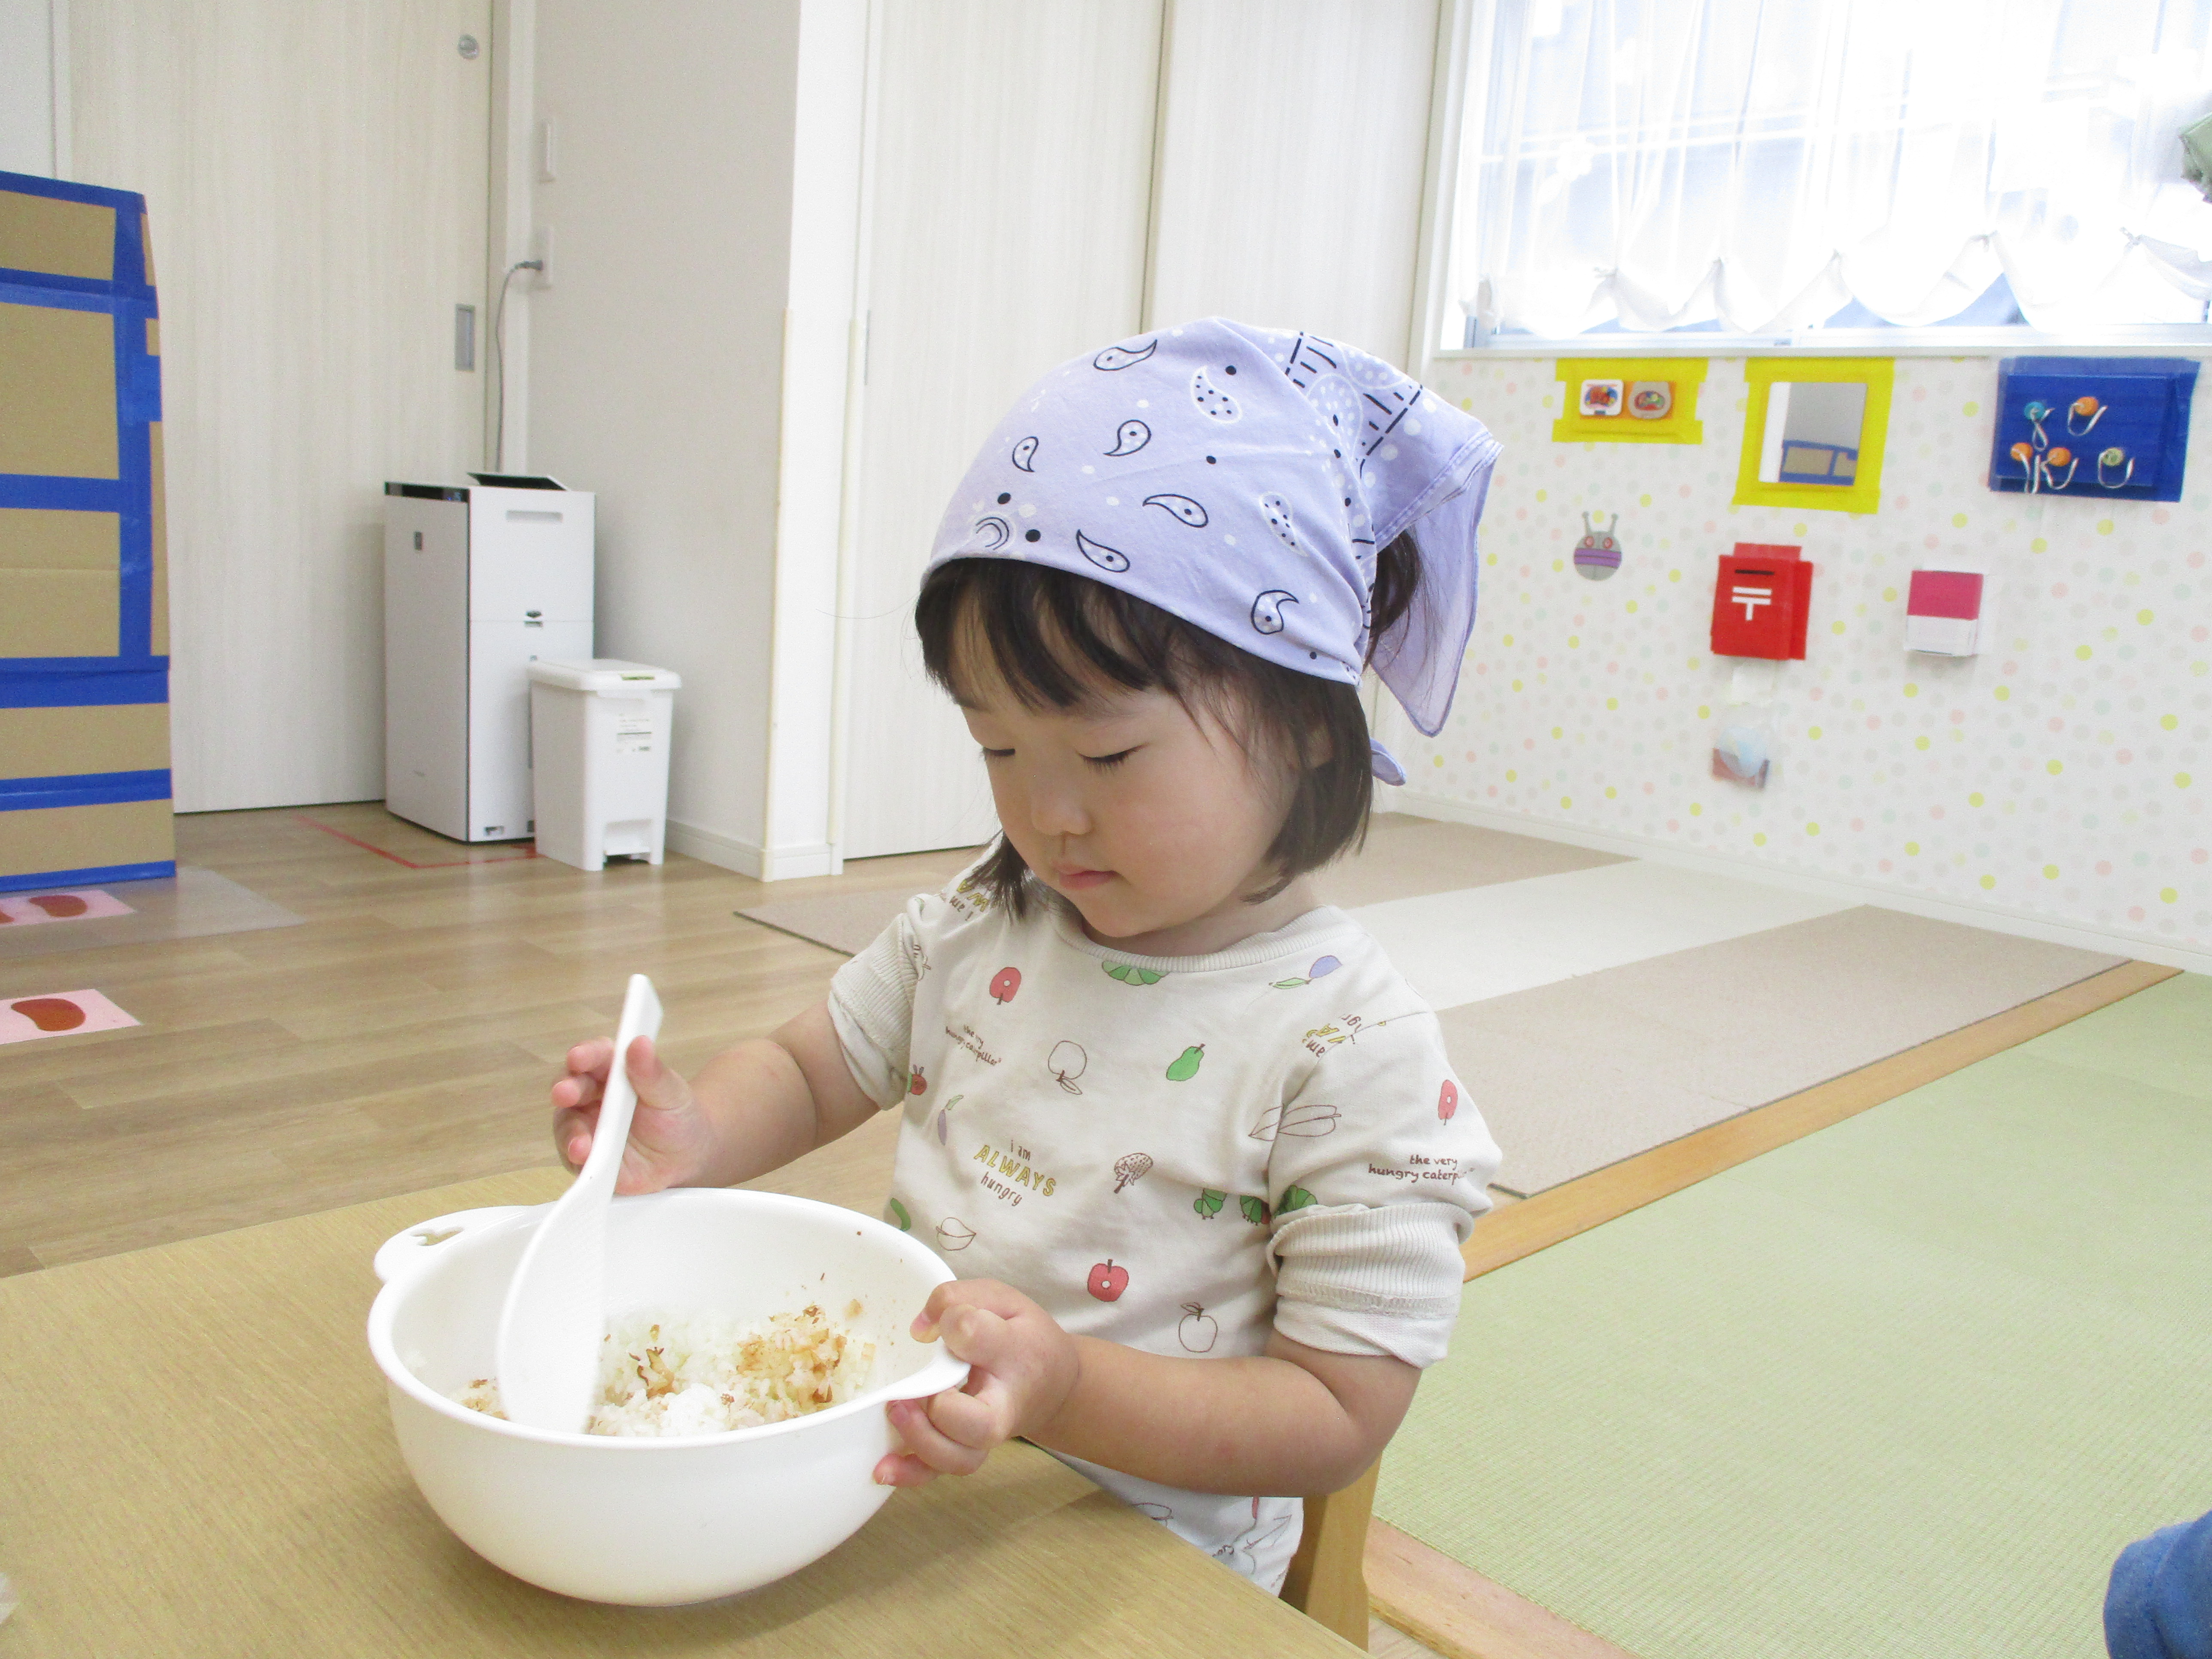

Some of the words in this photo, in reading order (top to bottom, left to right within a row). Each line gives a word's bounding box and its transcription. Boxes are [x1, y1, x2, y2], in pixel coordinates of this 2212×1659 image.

[1011, 1140, 1013, 1152] i
[1018, 1146, 1030, 1161] am
[973, 1145, 1056, 1196] ALWAYS
[1410, 1155, 1430, 1164] the
[1433, 1158, 1458, 1170] very
[1368, 1164, 1419, 1183] hungry
[981, 1171, 1022, 1206] hungry
